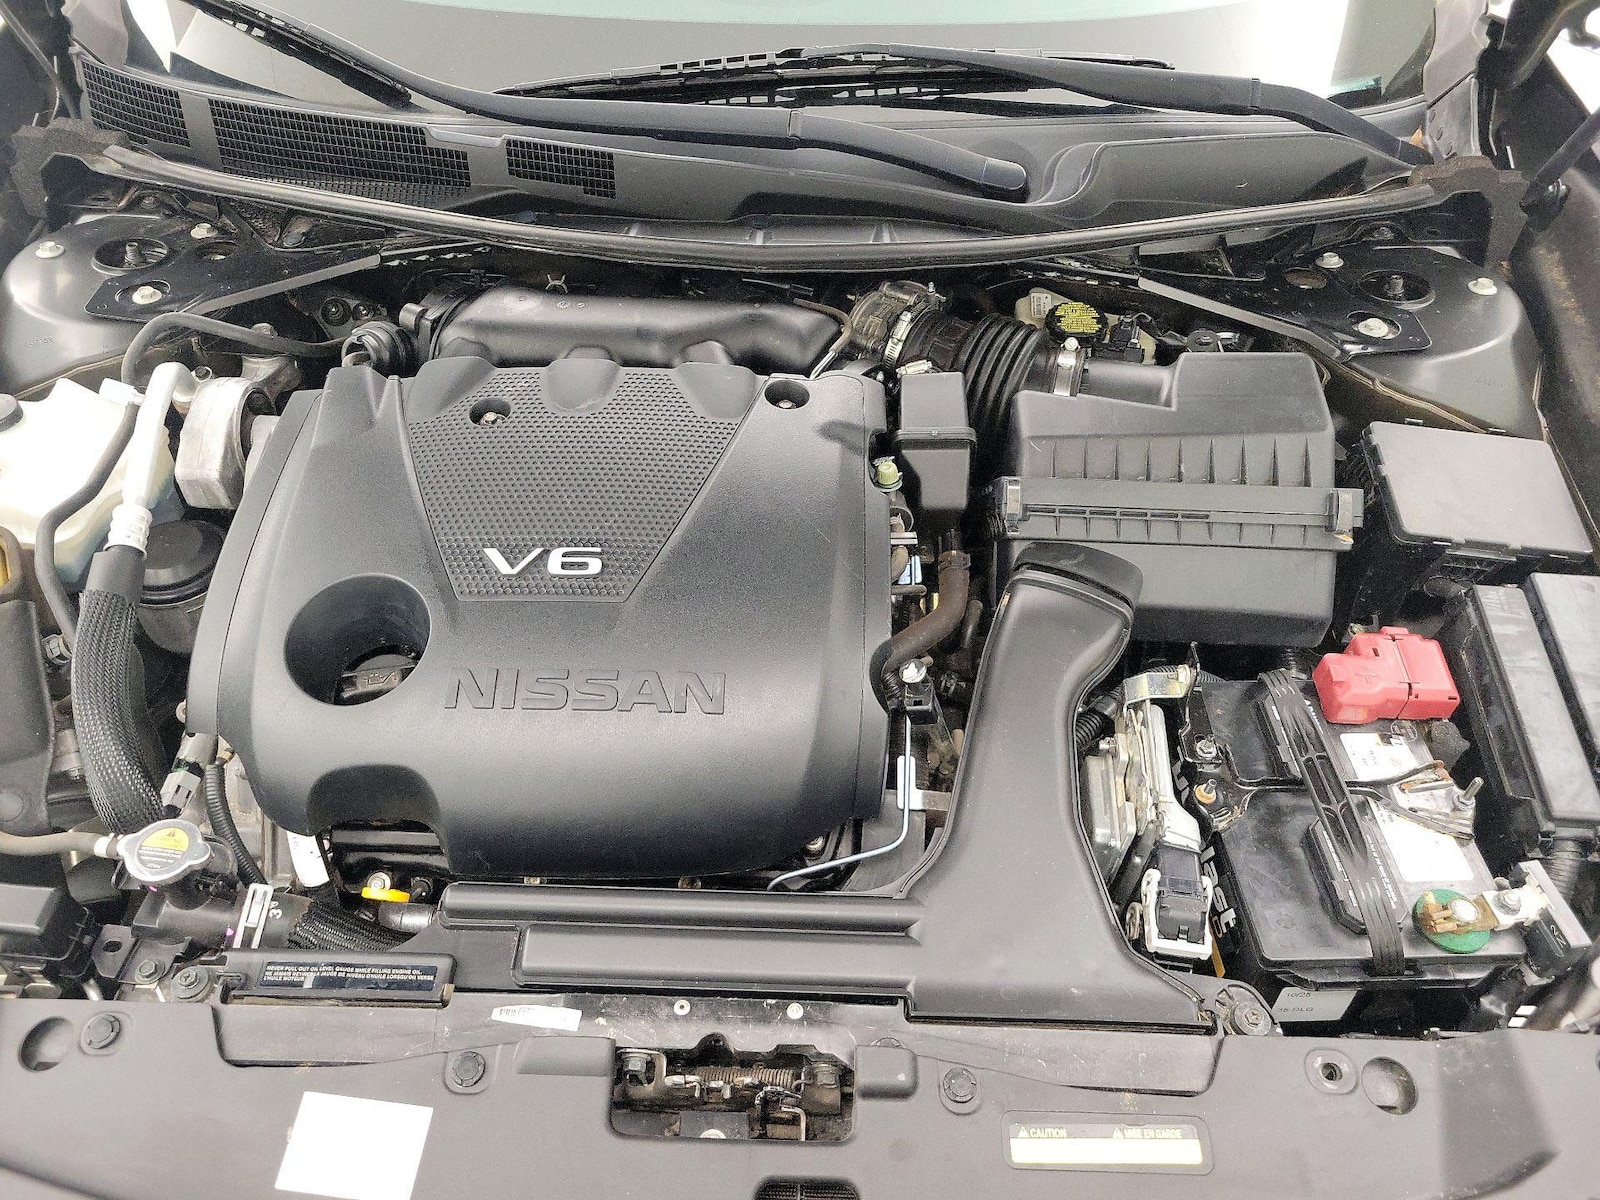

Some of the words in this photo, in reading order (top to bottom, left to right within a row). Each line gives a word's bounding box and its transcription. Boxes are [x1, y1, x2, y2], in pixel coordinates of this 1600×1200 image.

[483, 547, 602, 575] V6
[444, 668, 727, 715] NISSAN
[1029, 1127, 1067, 1138] CAUTION
[1143, 1128, 1155, 1139] EN
